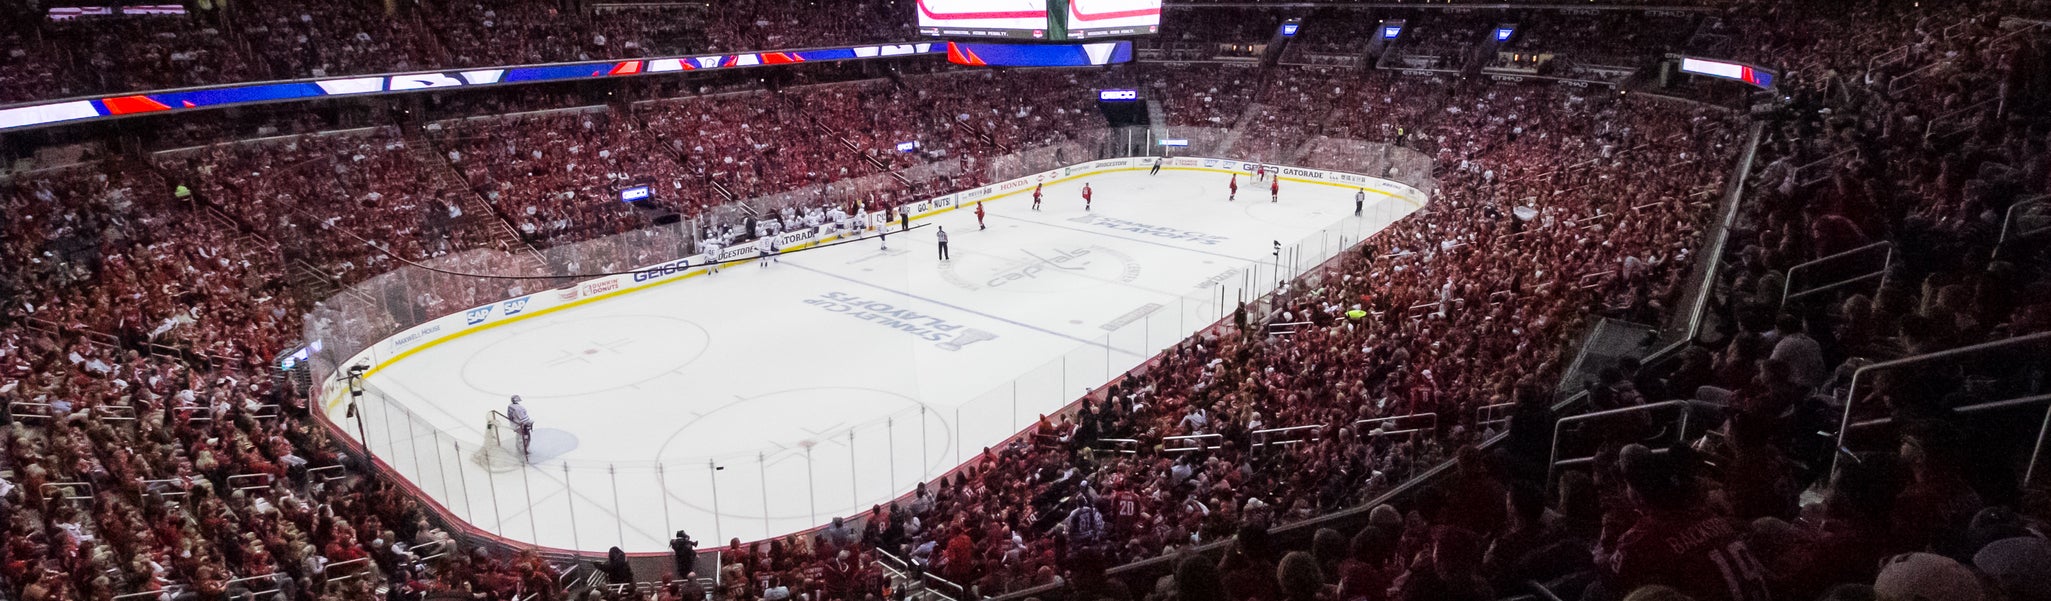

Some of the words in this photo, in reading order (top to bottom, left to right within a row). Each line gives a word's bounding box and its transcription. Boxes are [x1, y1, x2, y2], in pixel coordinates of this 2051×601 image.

[1101, 91, 1135, 99] GEICO
[1243, 163, 1280, 174] GECO
[1283, 168, 1324, 179] GATORADE
[1000, 179, 1029, 191] HONDA
[634, 259, 689, 282] GEICO
[592, 283, 620, 295] DONUTS
[504, 299, 526, 313] SAP
[802, 298, 852, 313] CUP
[820, 291, 963, 331] PLAYOFFS
[468, 308, 490, 322] SAP
[848, 310, 952, 342] STANLEY
[395, 332, 421, 346] MAXWELL
[421, 324, 441, 337] HOUSE
[1119, 501, 1135, 516] 20
